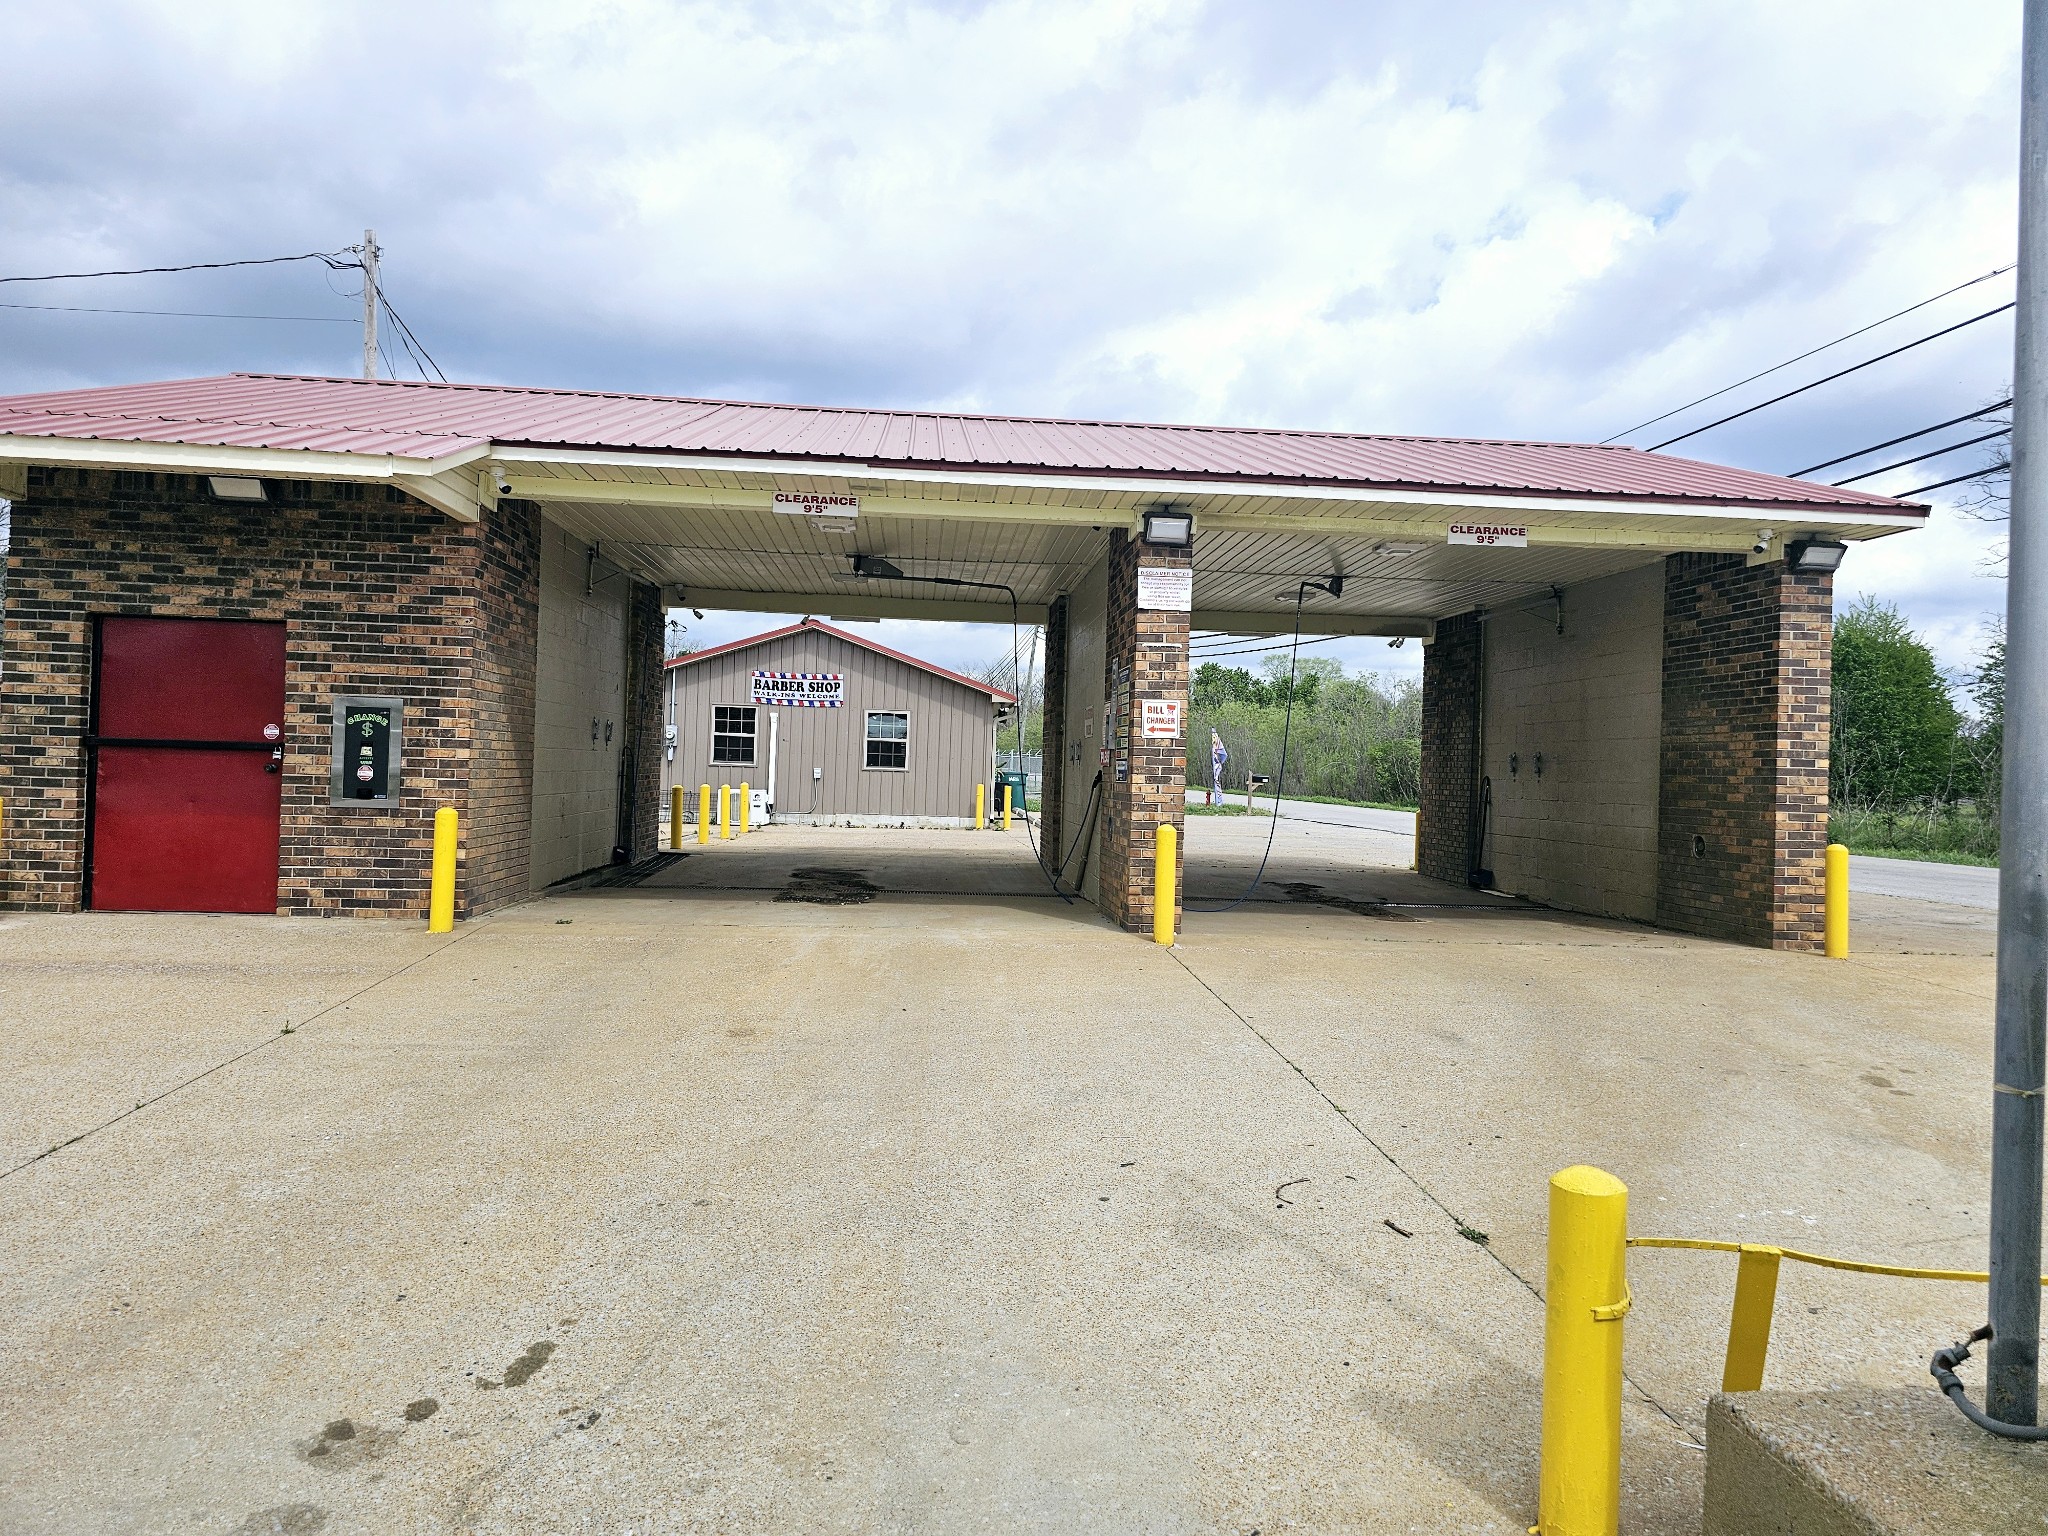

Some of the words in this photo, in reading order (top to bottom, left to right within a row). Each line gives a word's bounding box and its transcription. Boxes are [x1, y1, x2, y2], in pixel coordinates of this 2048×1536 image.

[774, 493, 857, 506] CLEARANCE
[803, 504, 828, 514] 9'5"
[1450, 525, 1526, 536] CLEARANCE
[1476, 535, 1500, 544] 9'5"
[754, 679, 804, 692] BARBER
[808, 681, 840, 693] SHOP
[754, 690, 796, 698] WALK-INS
[1148, 706, 1164, 714] BILL
[347, 714, 388, 726] CHANGE
[1146, 716, 1176, 724] CHANGER
[362, 721, 374, 738] $
